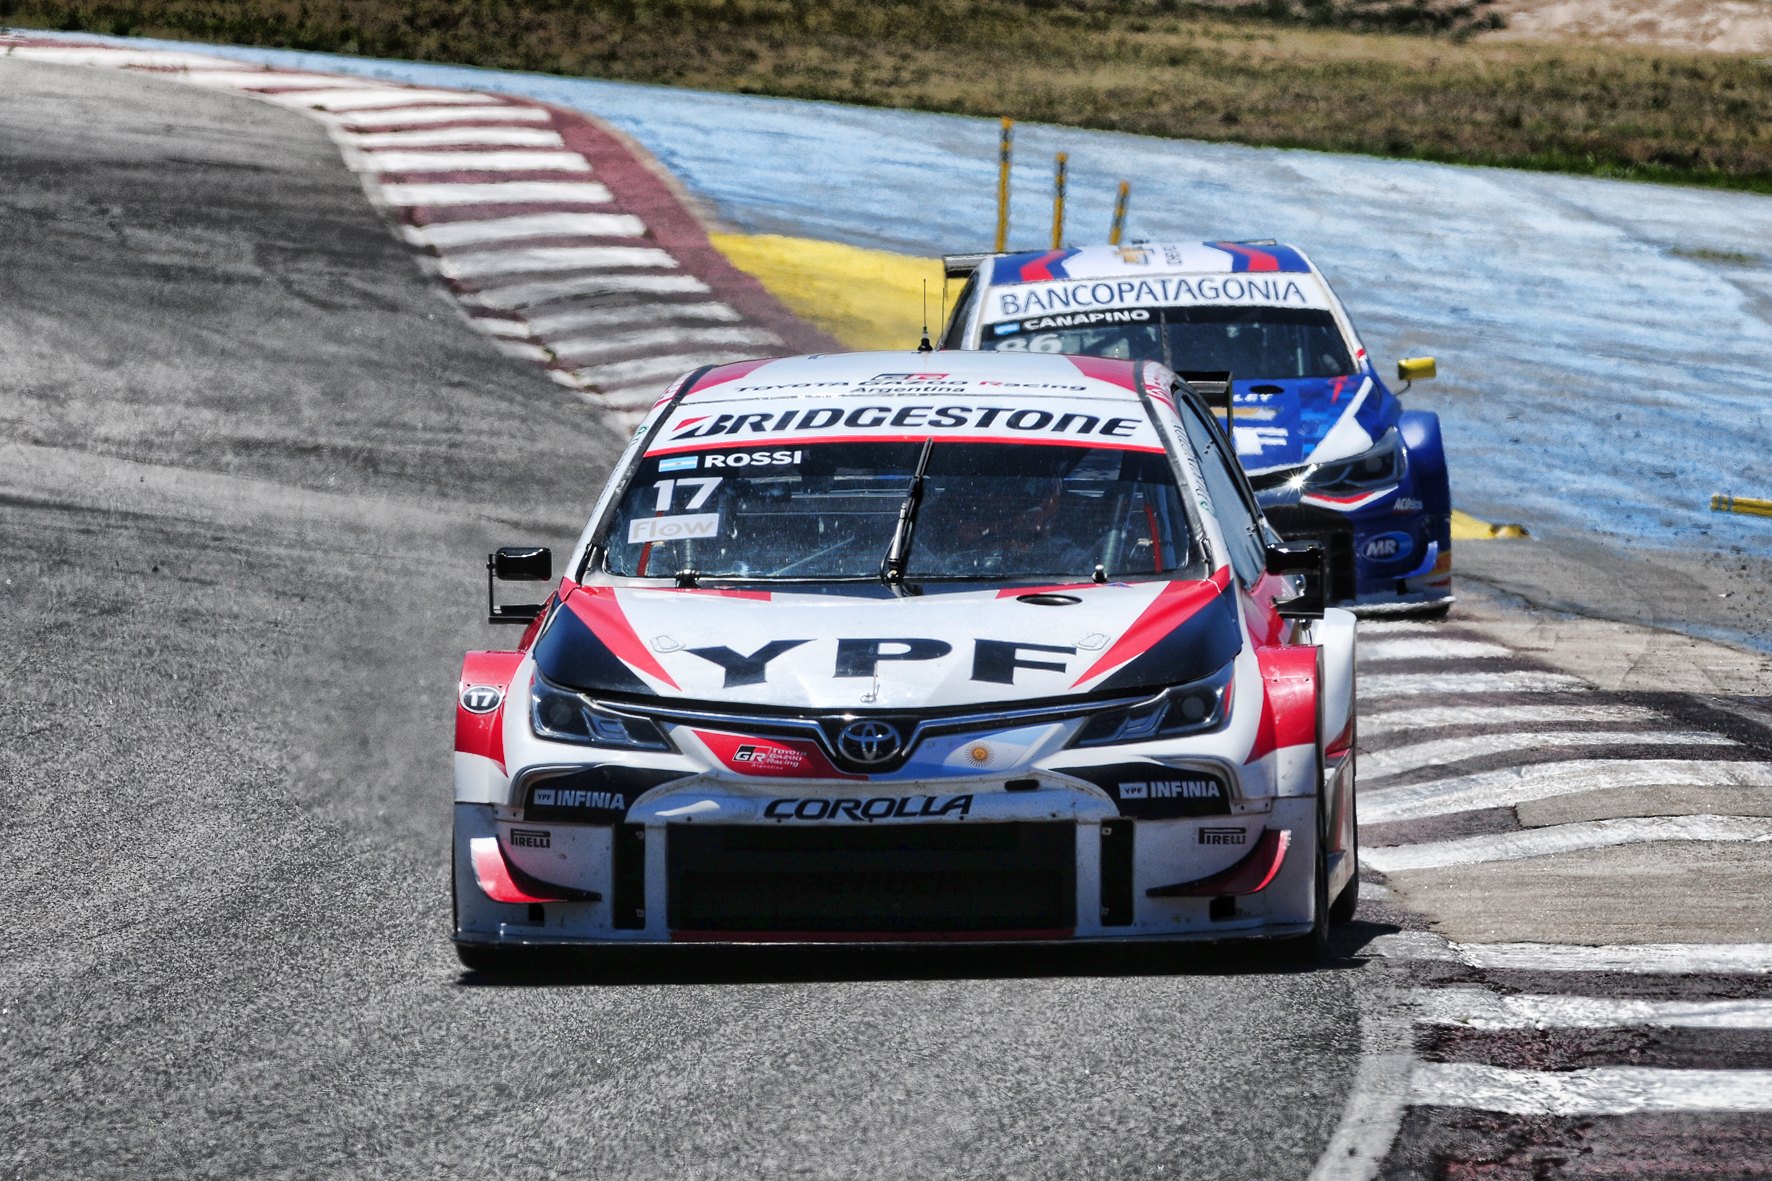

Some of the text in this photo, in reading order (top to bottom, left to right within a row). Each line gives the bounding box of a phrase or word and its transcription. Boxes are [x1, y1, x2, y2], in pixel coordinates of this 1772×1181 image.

[1001, 277, 1307, 315] BANCOPATAGONIA
[1022, 309, 1150, 331] CANAPINO
[735, 381, 850, 392] TOYOTA
[978, 381, 1087, 392] Racing
[849, 386, 966, 395] Argentina
[668, 405, 1143, 441] BRIDGESTONE
[704, 450, 802, 469] ROSSI
[653, 476, 723, 512] 17
[1366, 540, 1398, 557] MR
[683, 638, 1078, 688] YPF
[470, 691, 495, 707] 17
[735, 751, 767, 763] GR
[769, 753, 802, 761] GAZOO
[772, 748, 808, 756] TOYOTA
[766, 758, 799, 768] Racing
[1124, 781, 1221, 798] YPF INFINIA
[537, 789, 626, 810] YPF INFINIA
[764, 794, 974, 821] COROLLA
[510, 828, 551, 848] PIRELLI
[1198, 827, 1246, 844] PIRELLI
